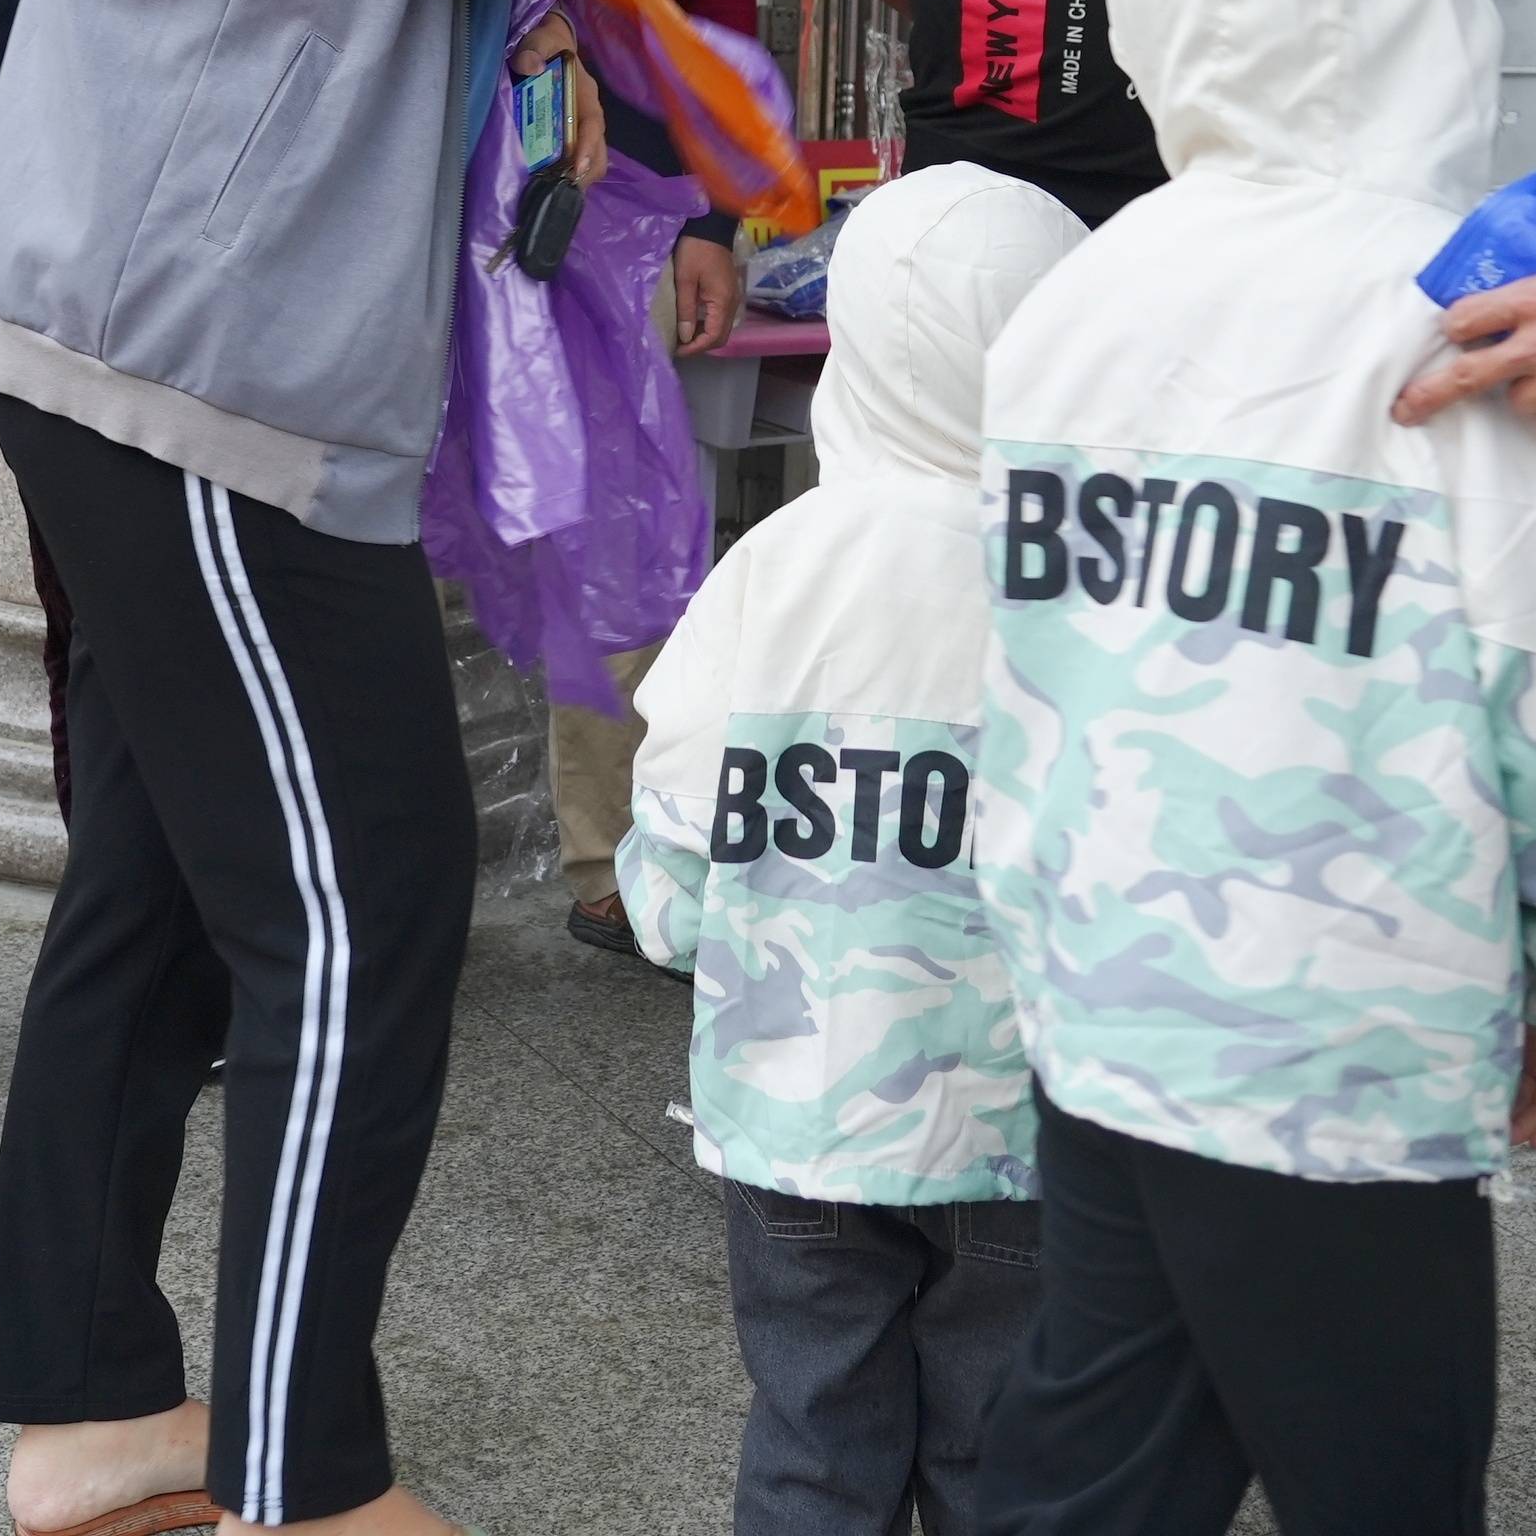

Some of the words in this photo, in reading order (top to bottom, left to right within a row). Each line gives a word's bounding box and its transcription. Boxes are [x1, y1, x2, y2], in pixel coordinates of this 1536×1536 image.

[1061, 49, 1082, 95] MADE
[1065, 25, 1084, 45] IN
[1003, 468, 1407, 660] BSTORY
[709, 741, 977, 873] BSTO
